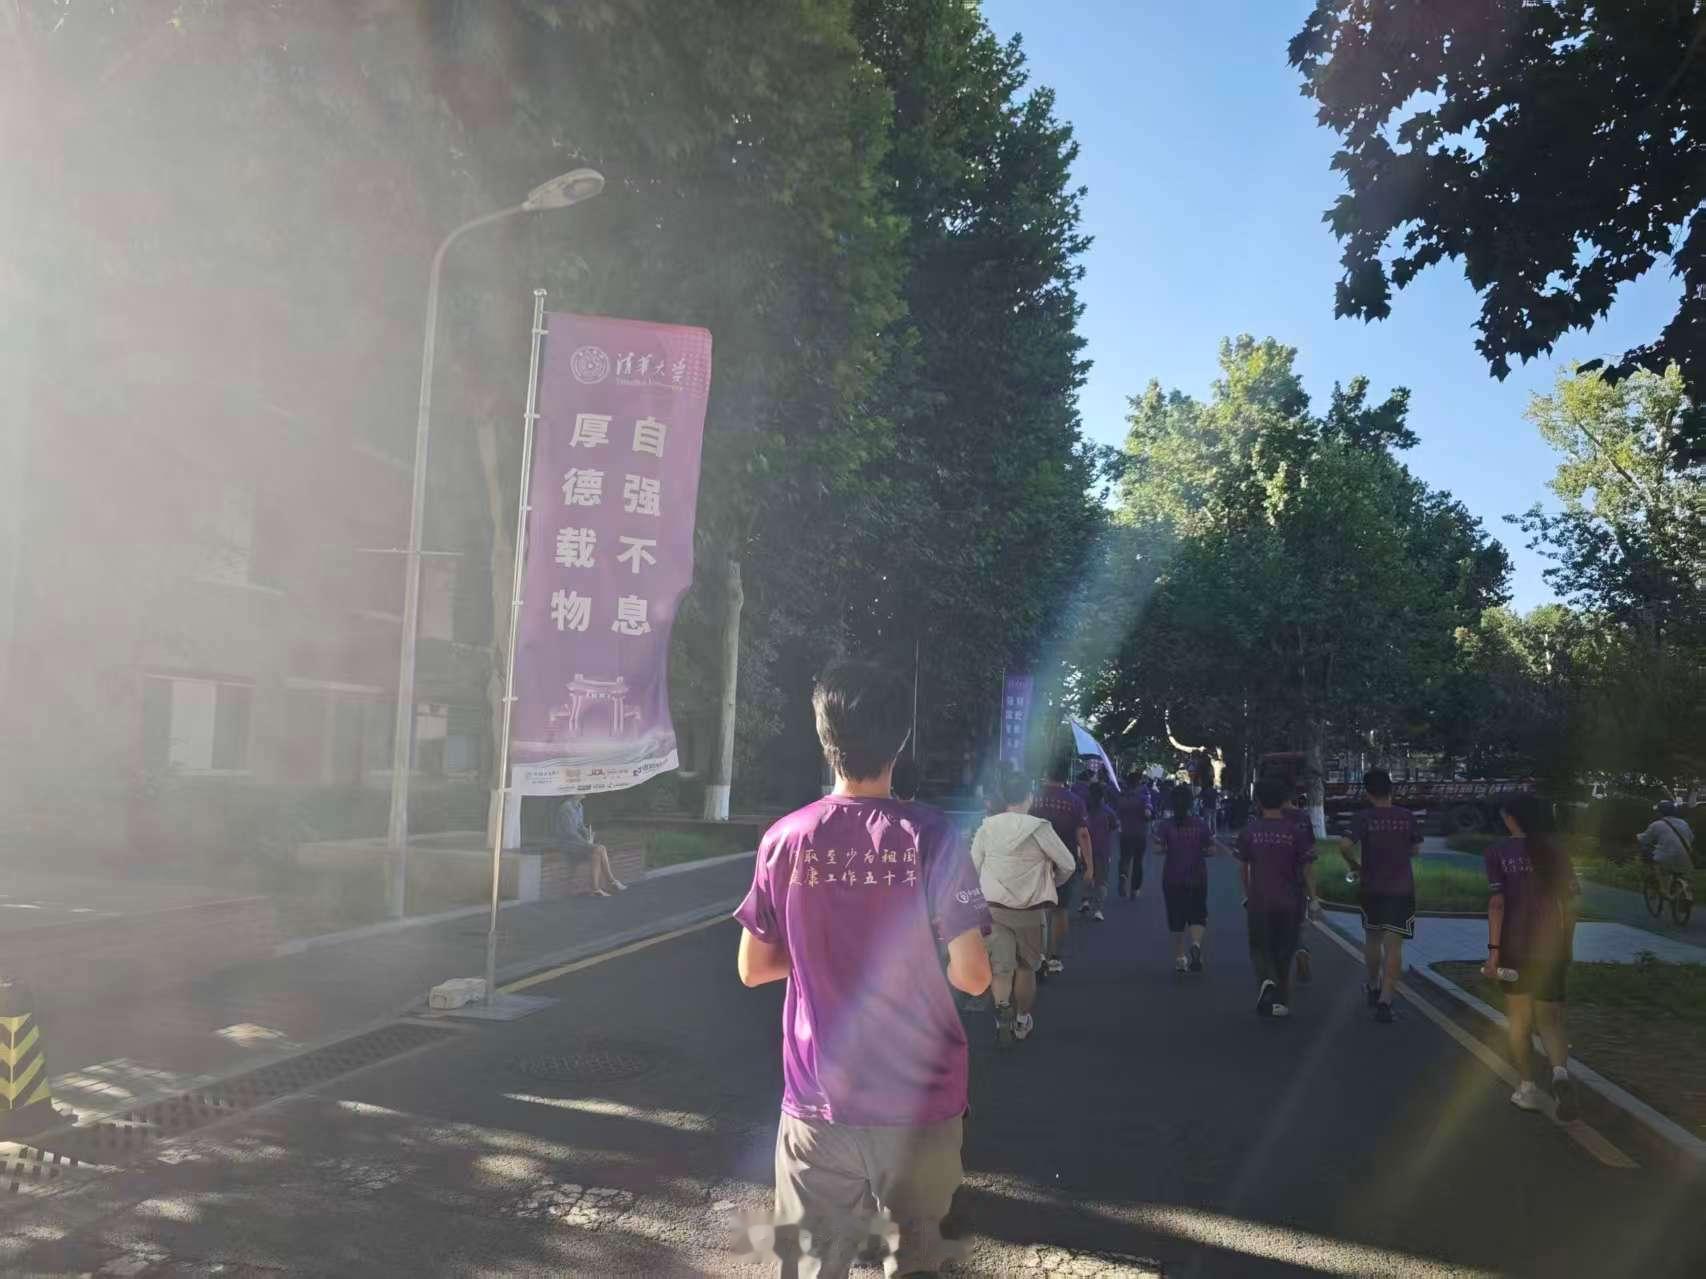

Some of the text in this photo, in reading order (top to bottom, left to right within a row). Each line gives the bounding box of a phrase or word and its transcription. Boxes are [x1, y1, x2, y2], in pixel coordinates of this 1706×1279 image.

[551, 413, 612, 632] 厚德载物
[611, 416, 667, 636] 自强不息
